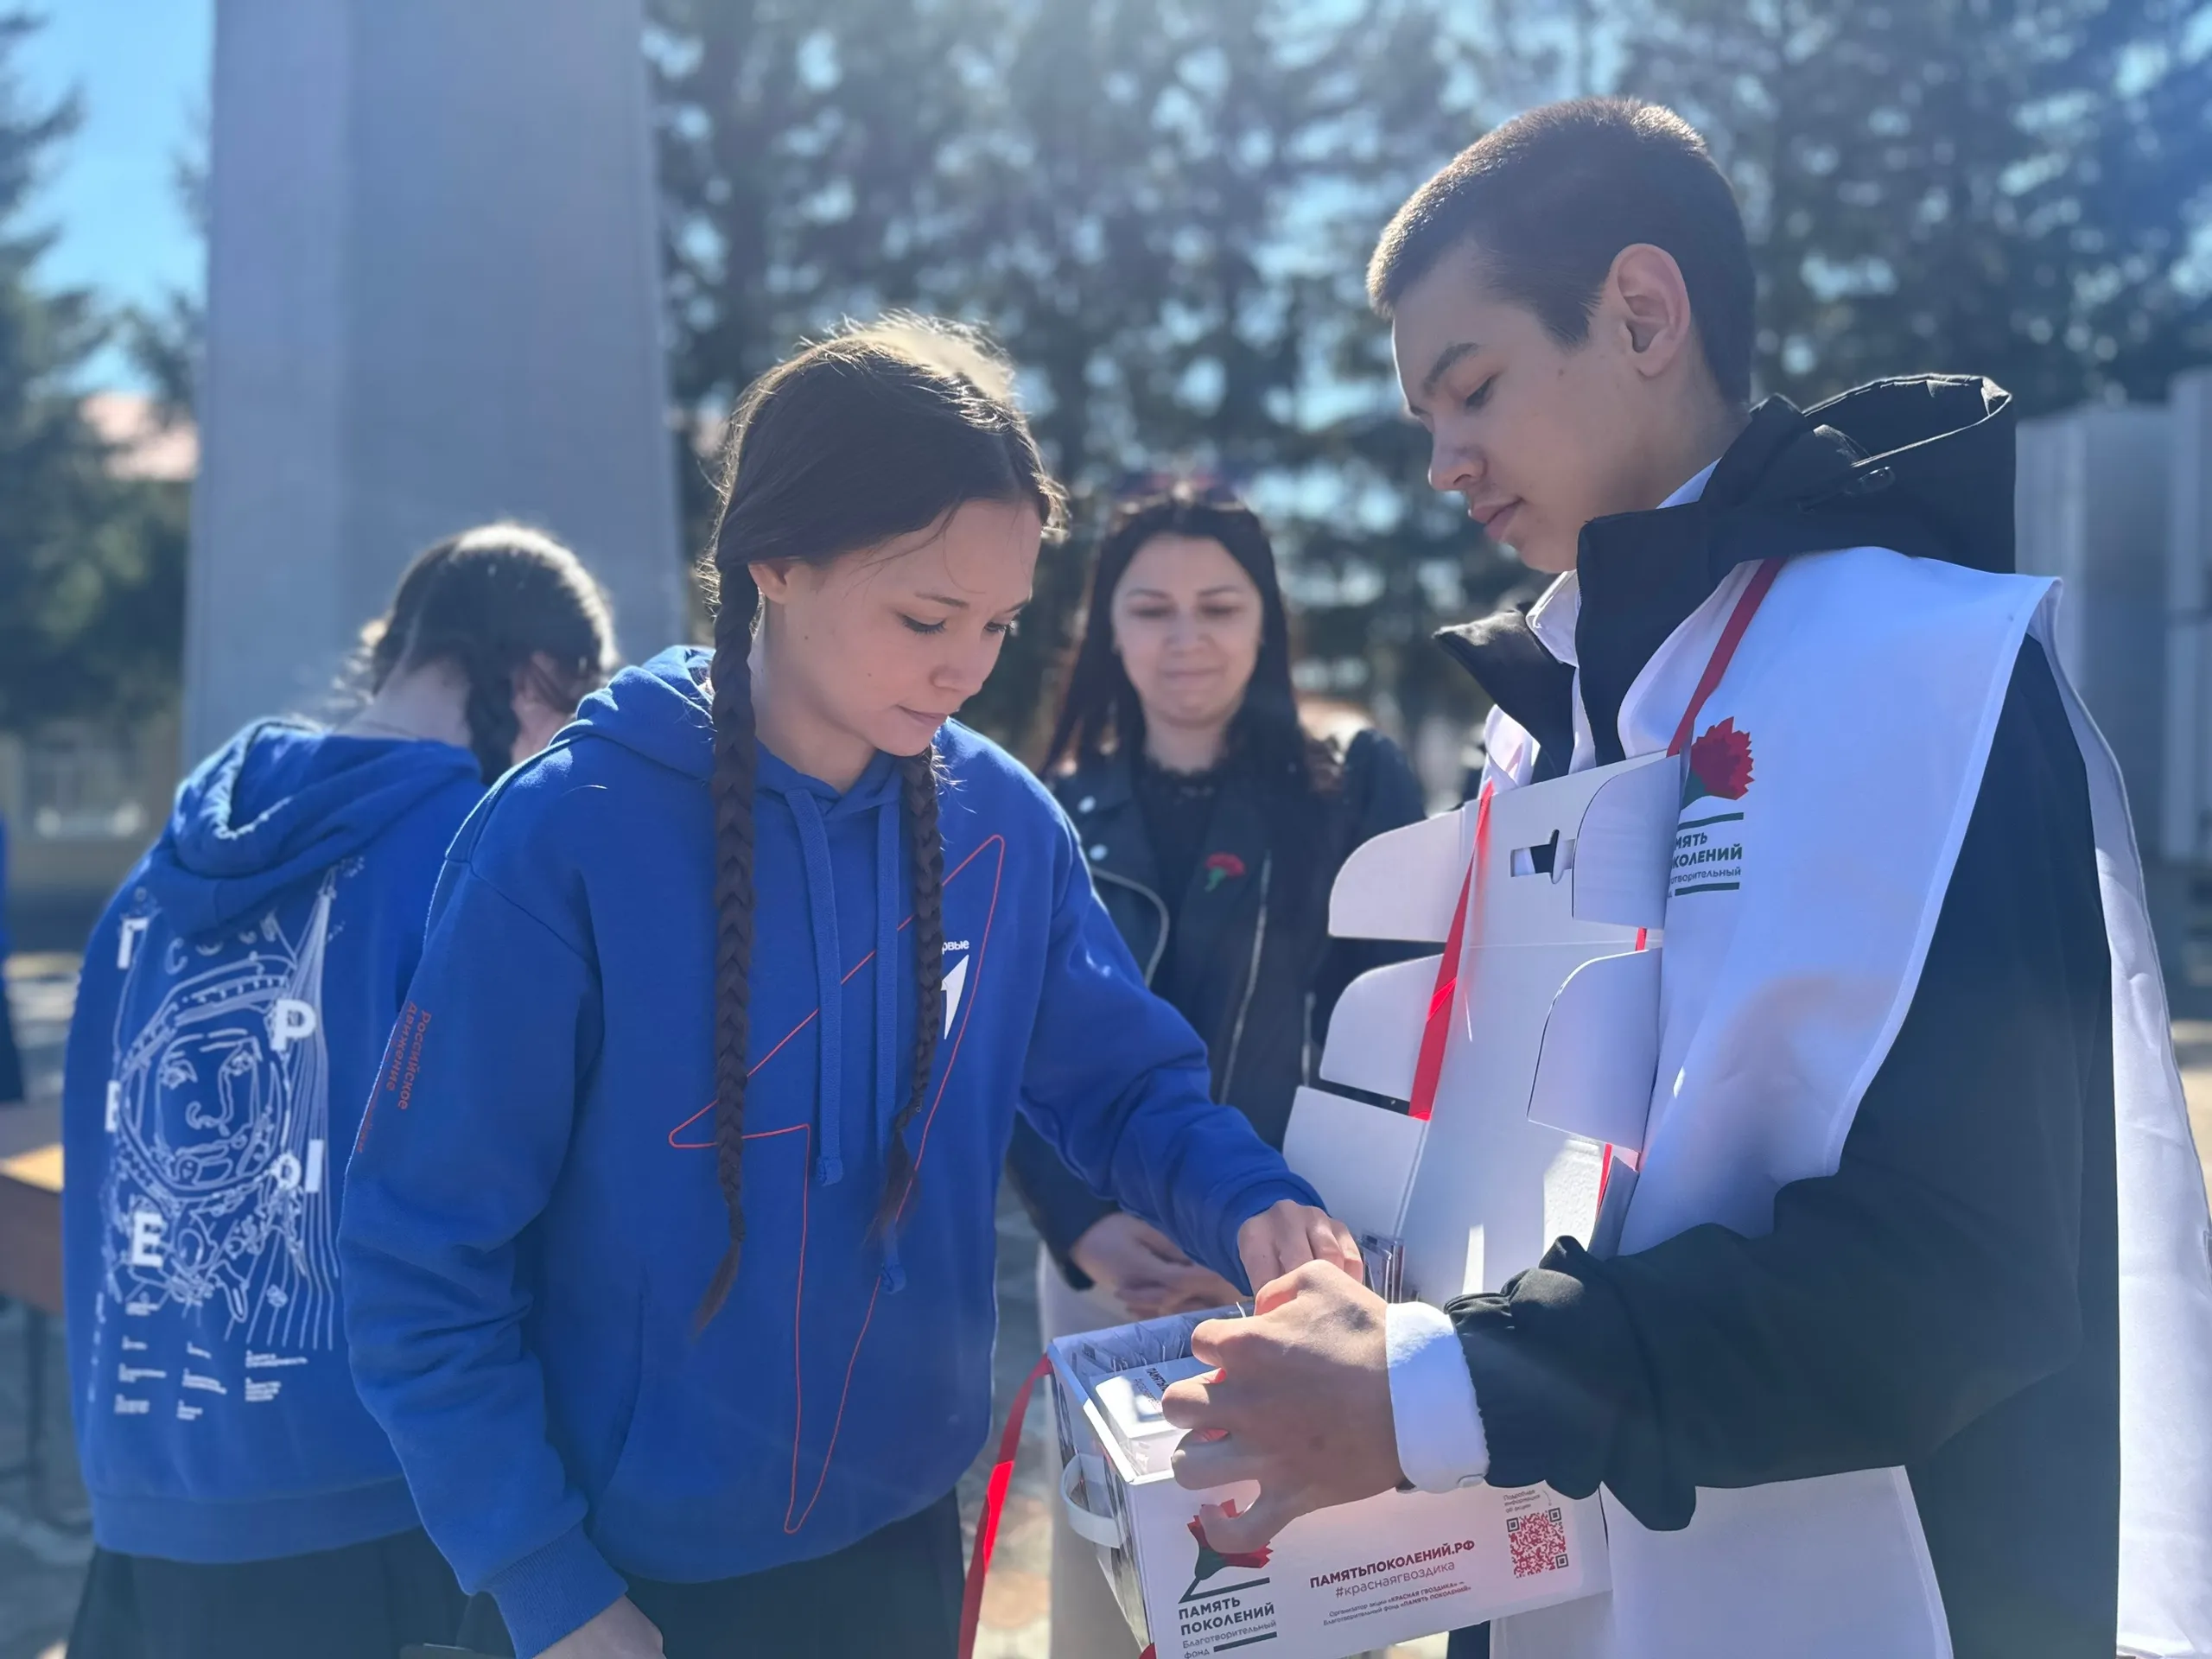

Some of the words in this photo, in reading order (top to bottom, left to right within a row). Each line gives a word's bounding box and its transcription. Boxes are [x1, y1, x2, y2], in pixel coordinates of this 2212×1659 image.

[1309, 1540, 1475, 1589] ПАМЯТЬПОКОЛЕНИЙ.РФ
[1335, 1561, 1455, 1599] #краснаягвоздика
[1179, 1597, 1241, 1620] ПАМЯТЬ
[1180, 1601, 1275, 1636] ПОКОЛЕНИЙ
[1182, 1619, 1277, 1649] Благотворительный
[1184, 1649, 1211, 1659] фонд
